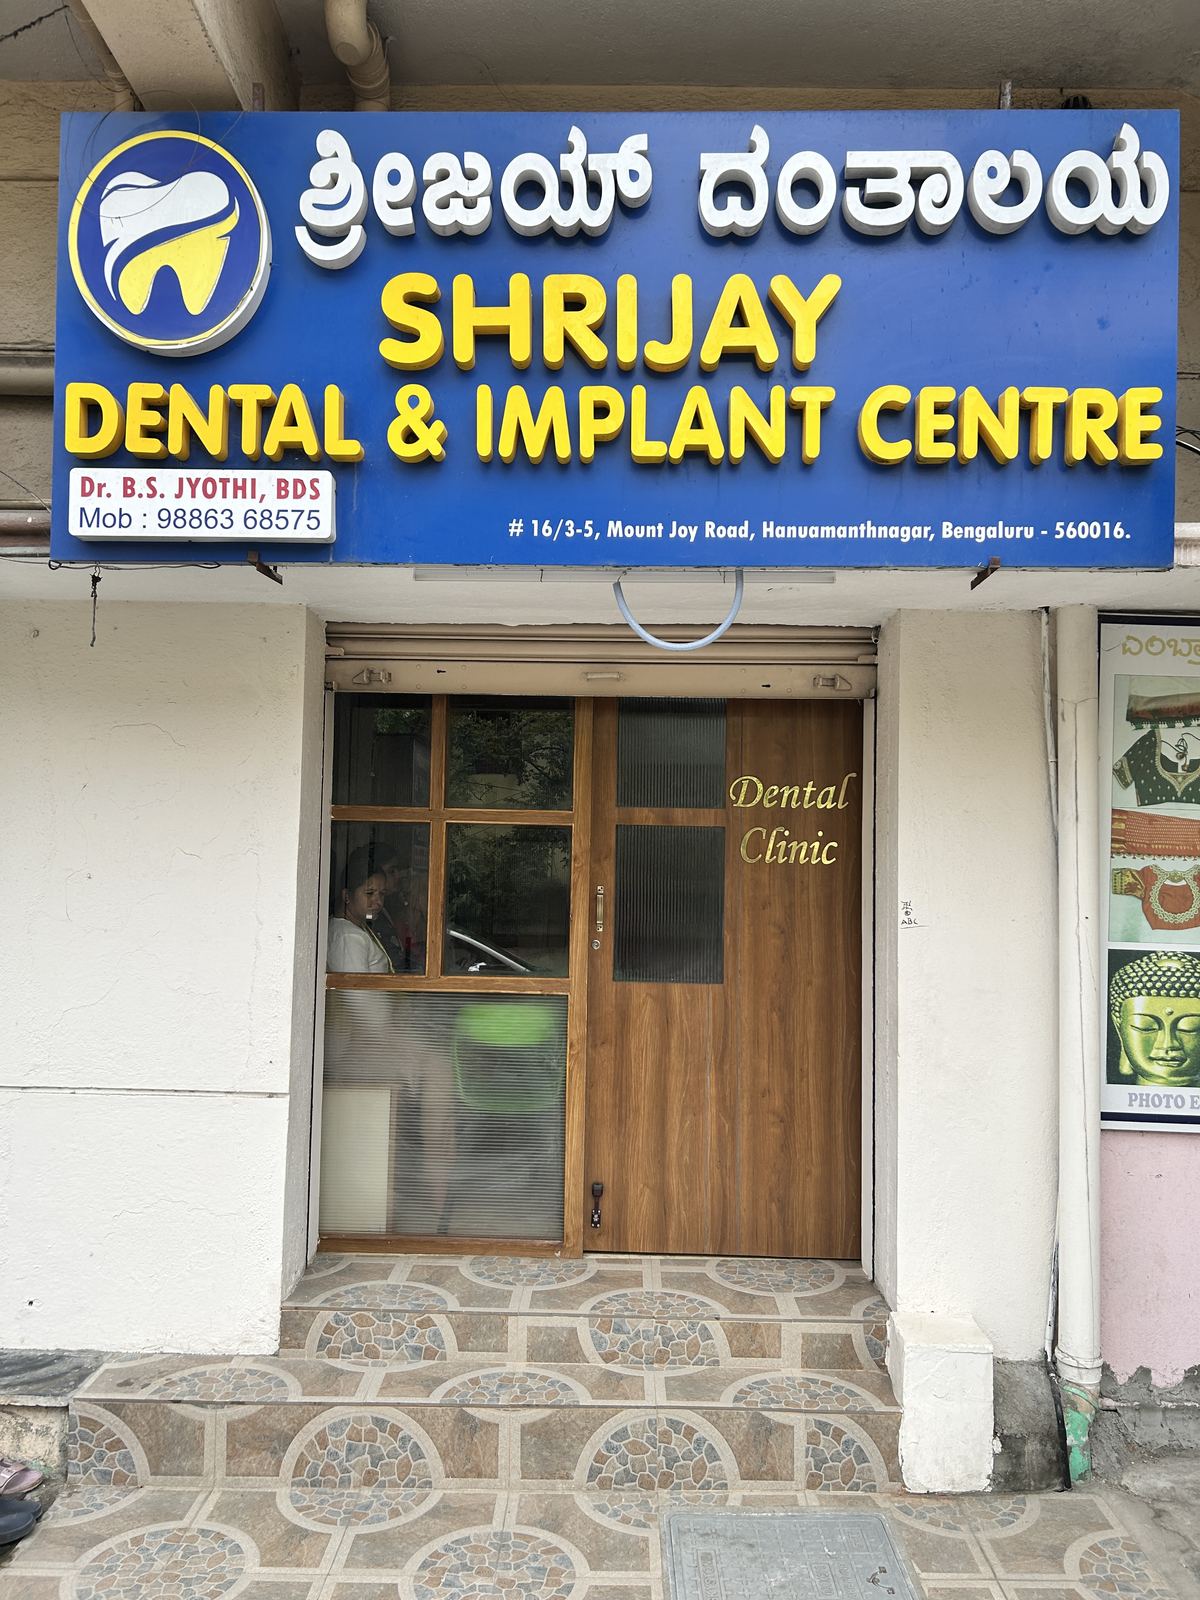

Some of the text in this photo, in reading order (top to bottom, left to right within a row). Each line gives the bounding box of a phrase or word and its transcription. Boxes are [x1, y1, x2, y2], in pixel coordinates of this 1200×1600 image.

[294, 123, 1169, 270] ಶ್ರೀಜಯ್ ದಂತಾಲಯ
[378, 271, 842, 373] SHRIJAY
[64, 382, 1164, 467] DENTAL & IMPLANT CENTRE
[80, 476, 321, 503] Dr. B.S. JYOTHI, BDS
[79, 507, 133, 529] Mob
[157, 508, 234, 530] 98863
[243, 509, 321, 531] 68575
[508, 518, 524, 537] #
[531, 519, 601, 541] 16/3-5,
[607, 520, 664, 538] Mount
[669, 520, 699, 543] Joy
[704, 520, 756, 541] Road,
[762, 520, 936, 542] Hanuamanthnagar,
[941, 520, 1035, 543] Bengaluru
[1054, 521, 1132, 540] 560016.
[729, 772, 857, 810] Dental
[740, 826, 838, 865] Clinic
[1127, 1092, 1186, 1109] PHOTO
